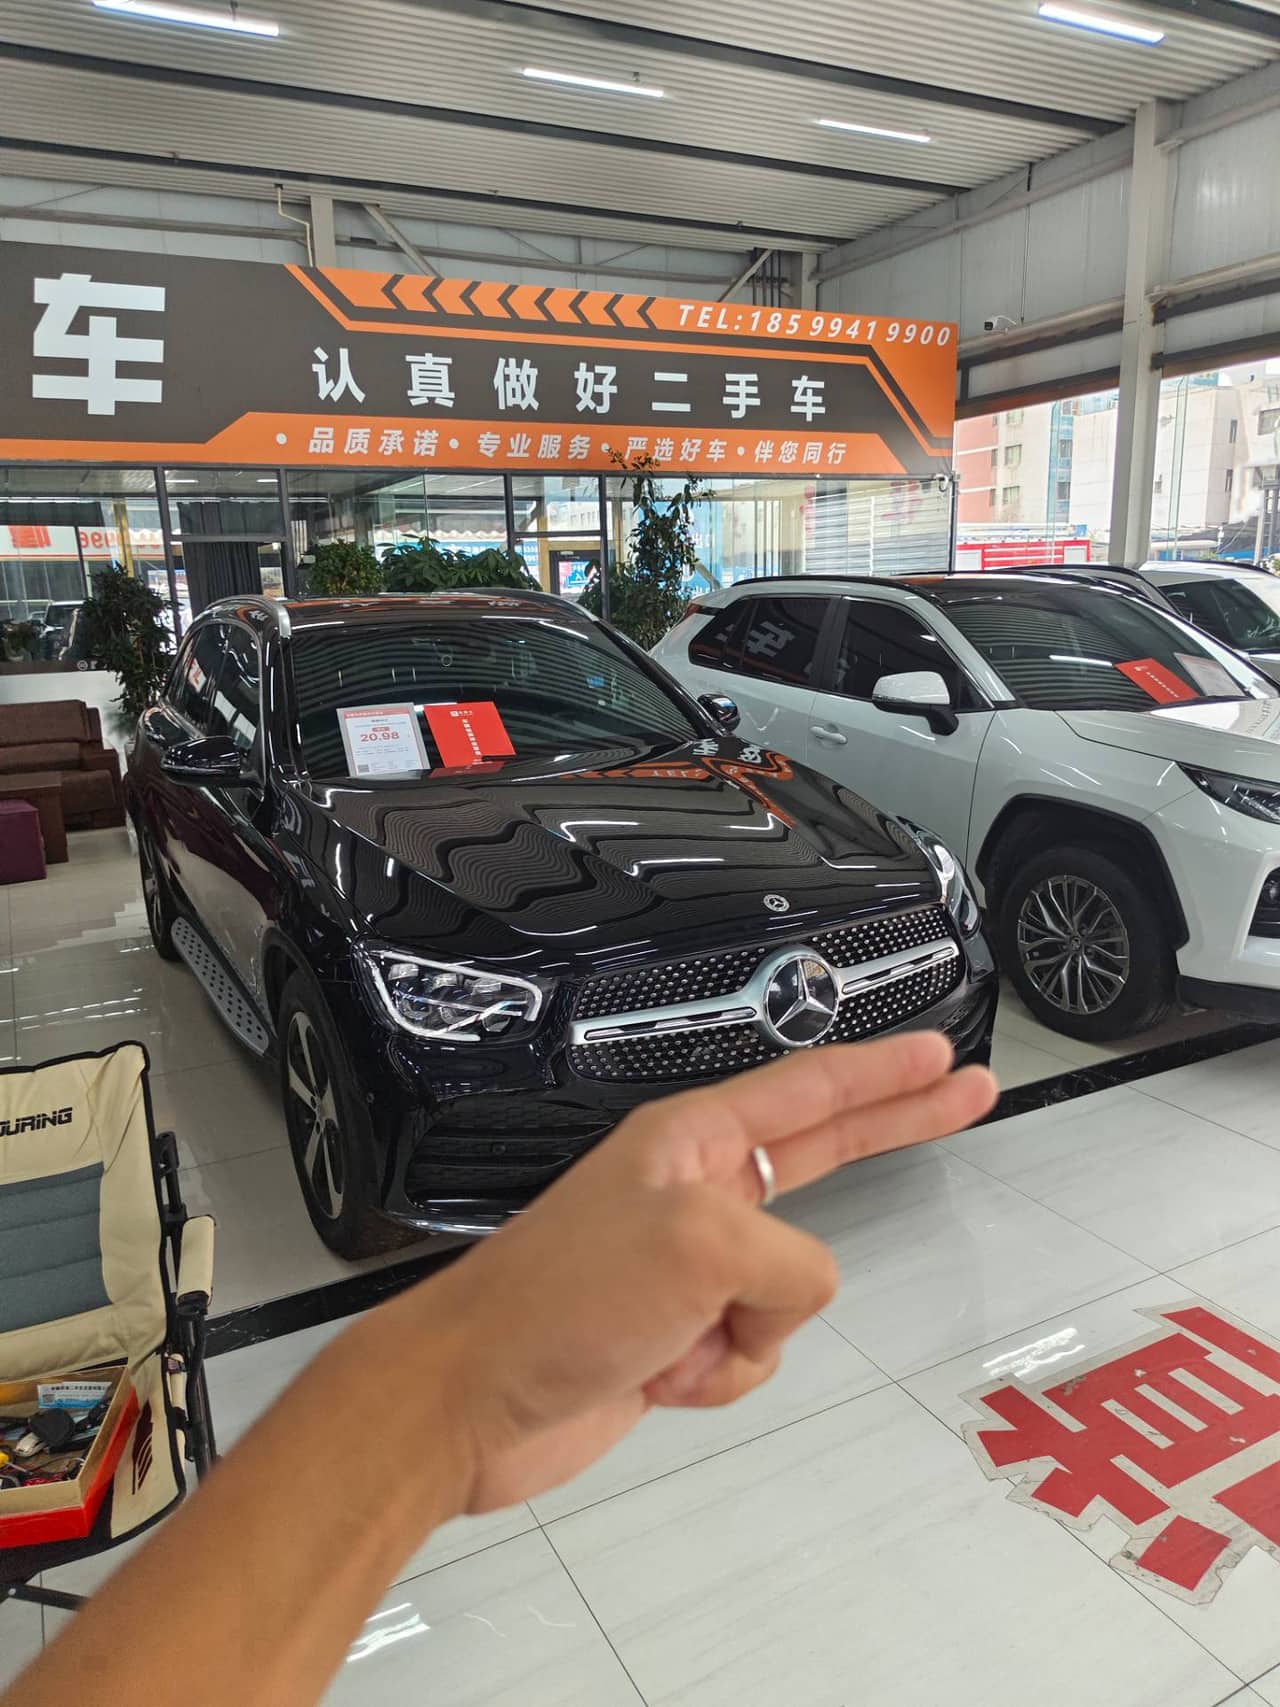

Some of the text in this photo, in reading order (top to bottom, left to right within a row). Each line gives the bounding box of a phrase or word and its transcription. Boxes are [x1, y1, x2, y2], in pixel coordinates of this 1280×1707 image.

[33, 273, 165, 415] 车
[809, 315, 877, 340] 9941
[886, 322, 950, 346] 9900
[312, 346, 826, 422] 认真做好二手车
[308, 426, 847, 465] 品质承诺 专业服务 严选好车 伴您同行
[360, 731, 400, 742] 20.98
